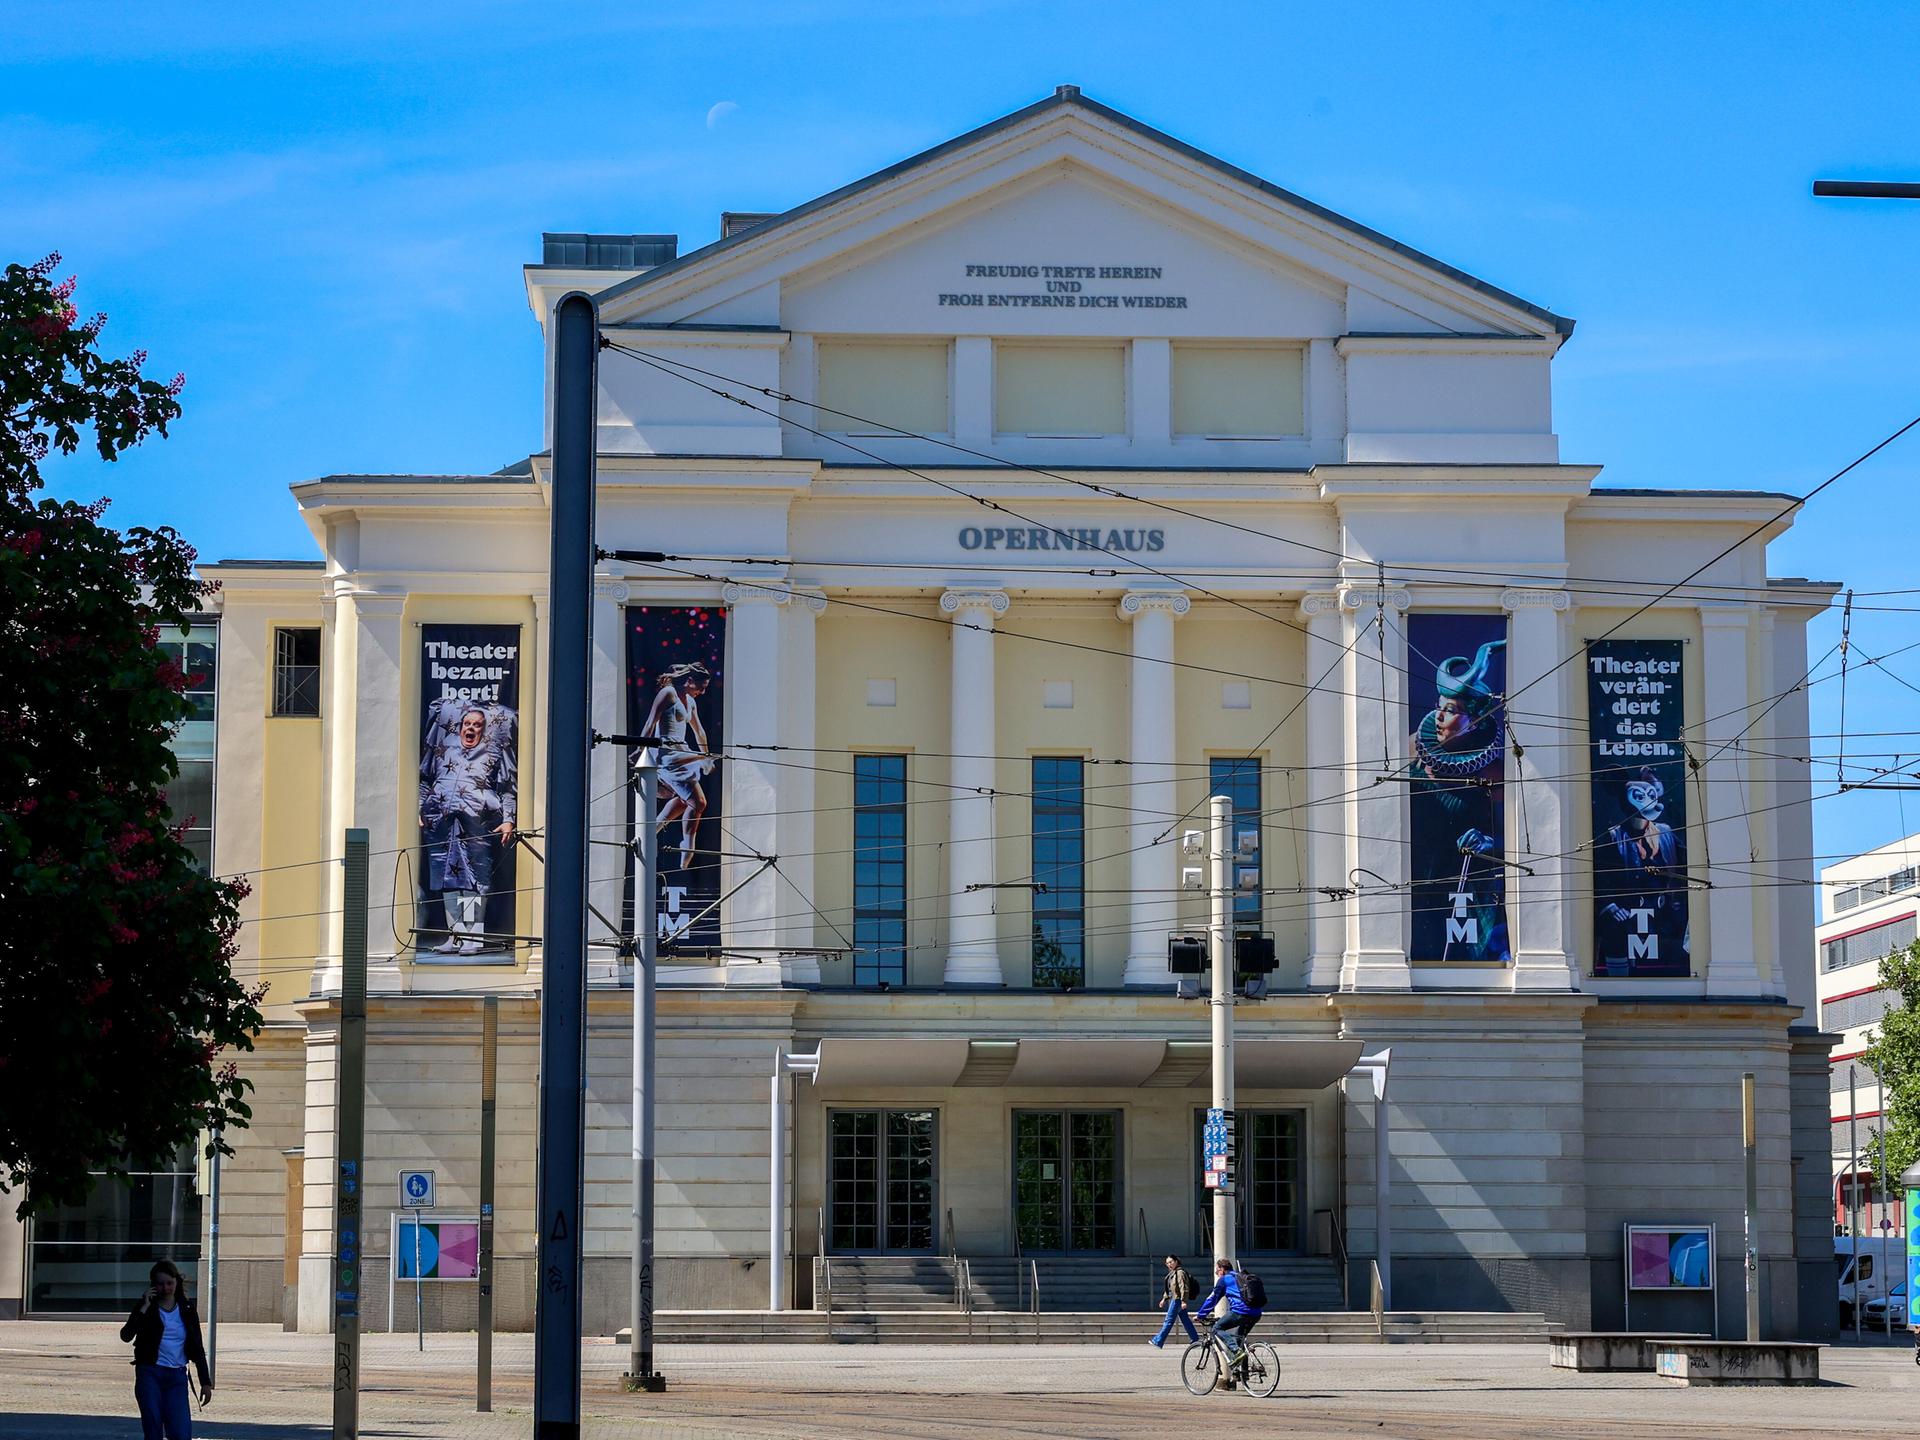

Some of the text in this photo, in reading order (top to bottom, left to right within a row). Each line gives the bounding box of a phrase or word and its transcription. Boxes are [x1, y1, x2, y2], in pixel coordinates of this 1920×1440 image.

[966, 265, 1162, 279] FREUDIG TRETE HEREIN
[1046, 281, 1081, 293] UND
[938, 294, 1188, 309] FROH ENTFERNE DICH WIEDER
[958, 527, 1165, 551] OPERNHAUS
[425, 641, 517, 660] Theater
[431, 662, 510, 680] bezau-
[1590, 656, 1680, 674] Theater
[441, 682, 499, 701] bert!
[1600, 676, 1672, 694] verän-
[1612, 697, 1660, 715] dert
[1616, 718, 1657, 736] das
[1599, 739, 1676, 756] Leben.
[457, 896, 482, 922] T
[661, 886, 687, 913] T
[1448, 892, 1474, 918] T
[658, 913, 690, 939] M
[1629, 908, 1655, 933] T
[1446, 918, 1478, 943] M
[1627, 934, 1659, 959] M
